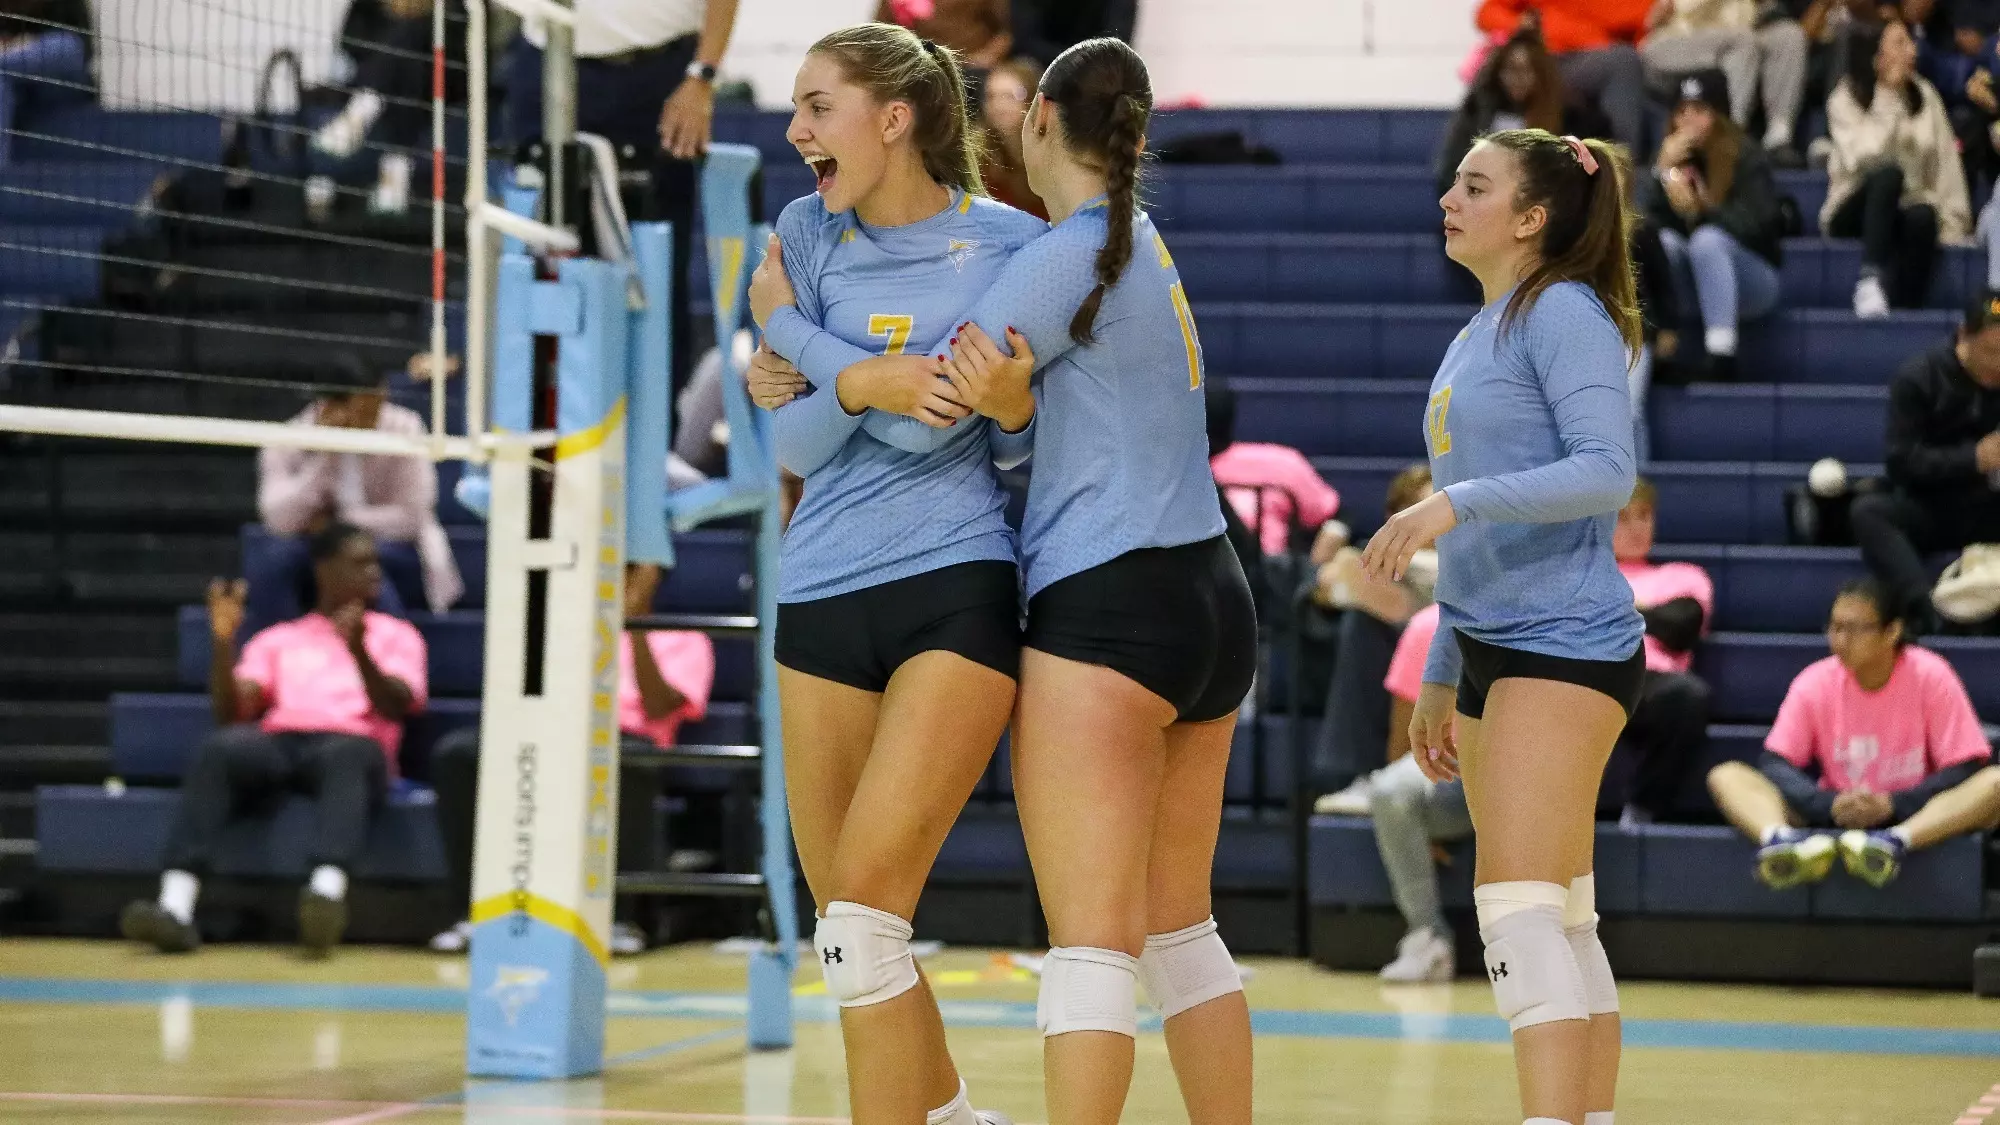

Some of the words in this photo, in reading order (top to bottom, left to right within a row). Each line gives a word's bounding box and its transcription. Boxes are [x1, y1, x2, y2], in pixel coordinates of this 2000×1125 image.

[868, 314, 914, 355] 7
[515, 742, 537, 826] sports
[508, 832, 534, 937] imports
